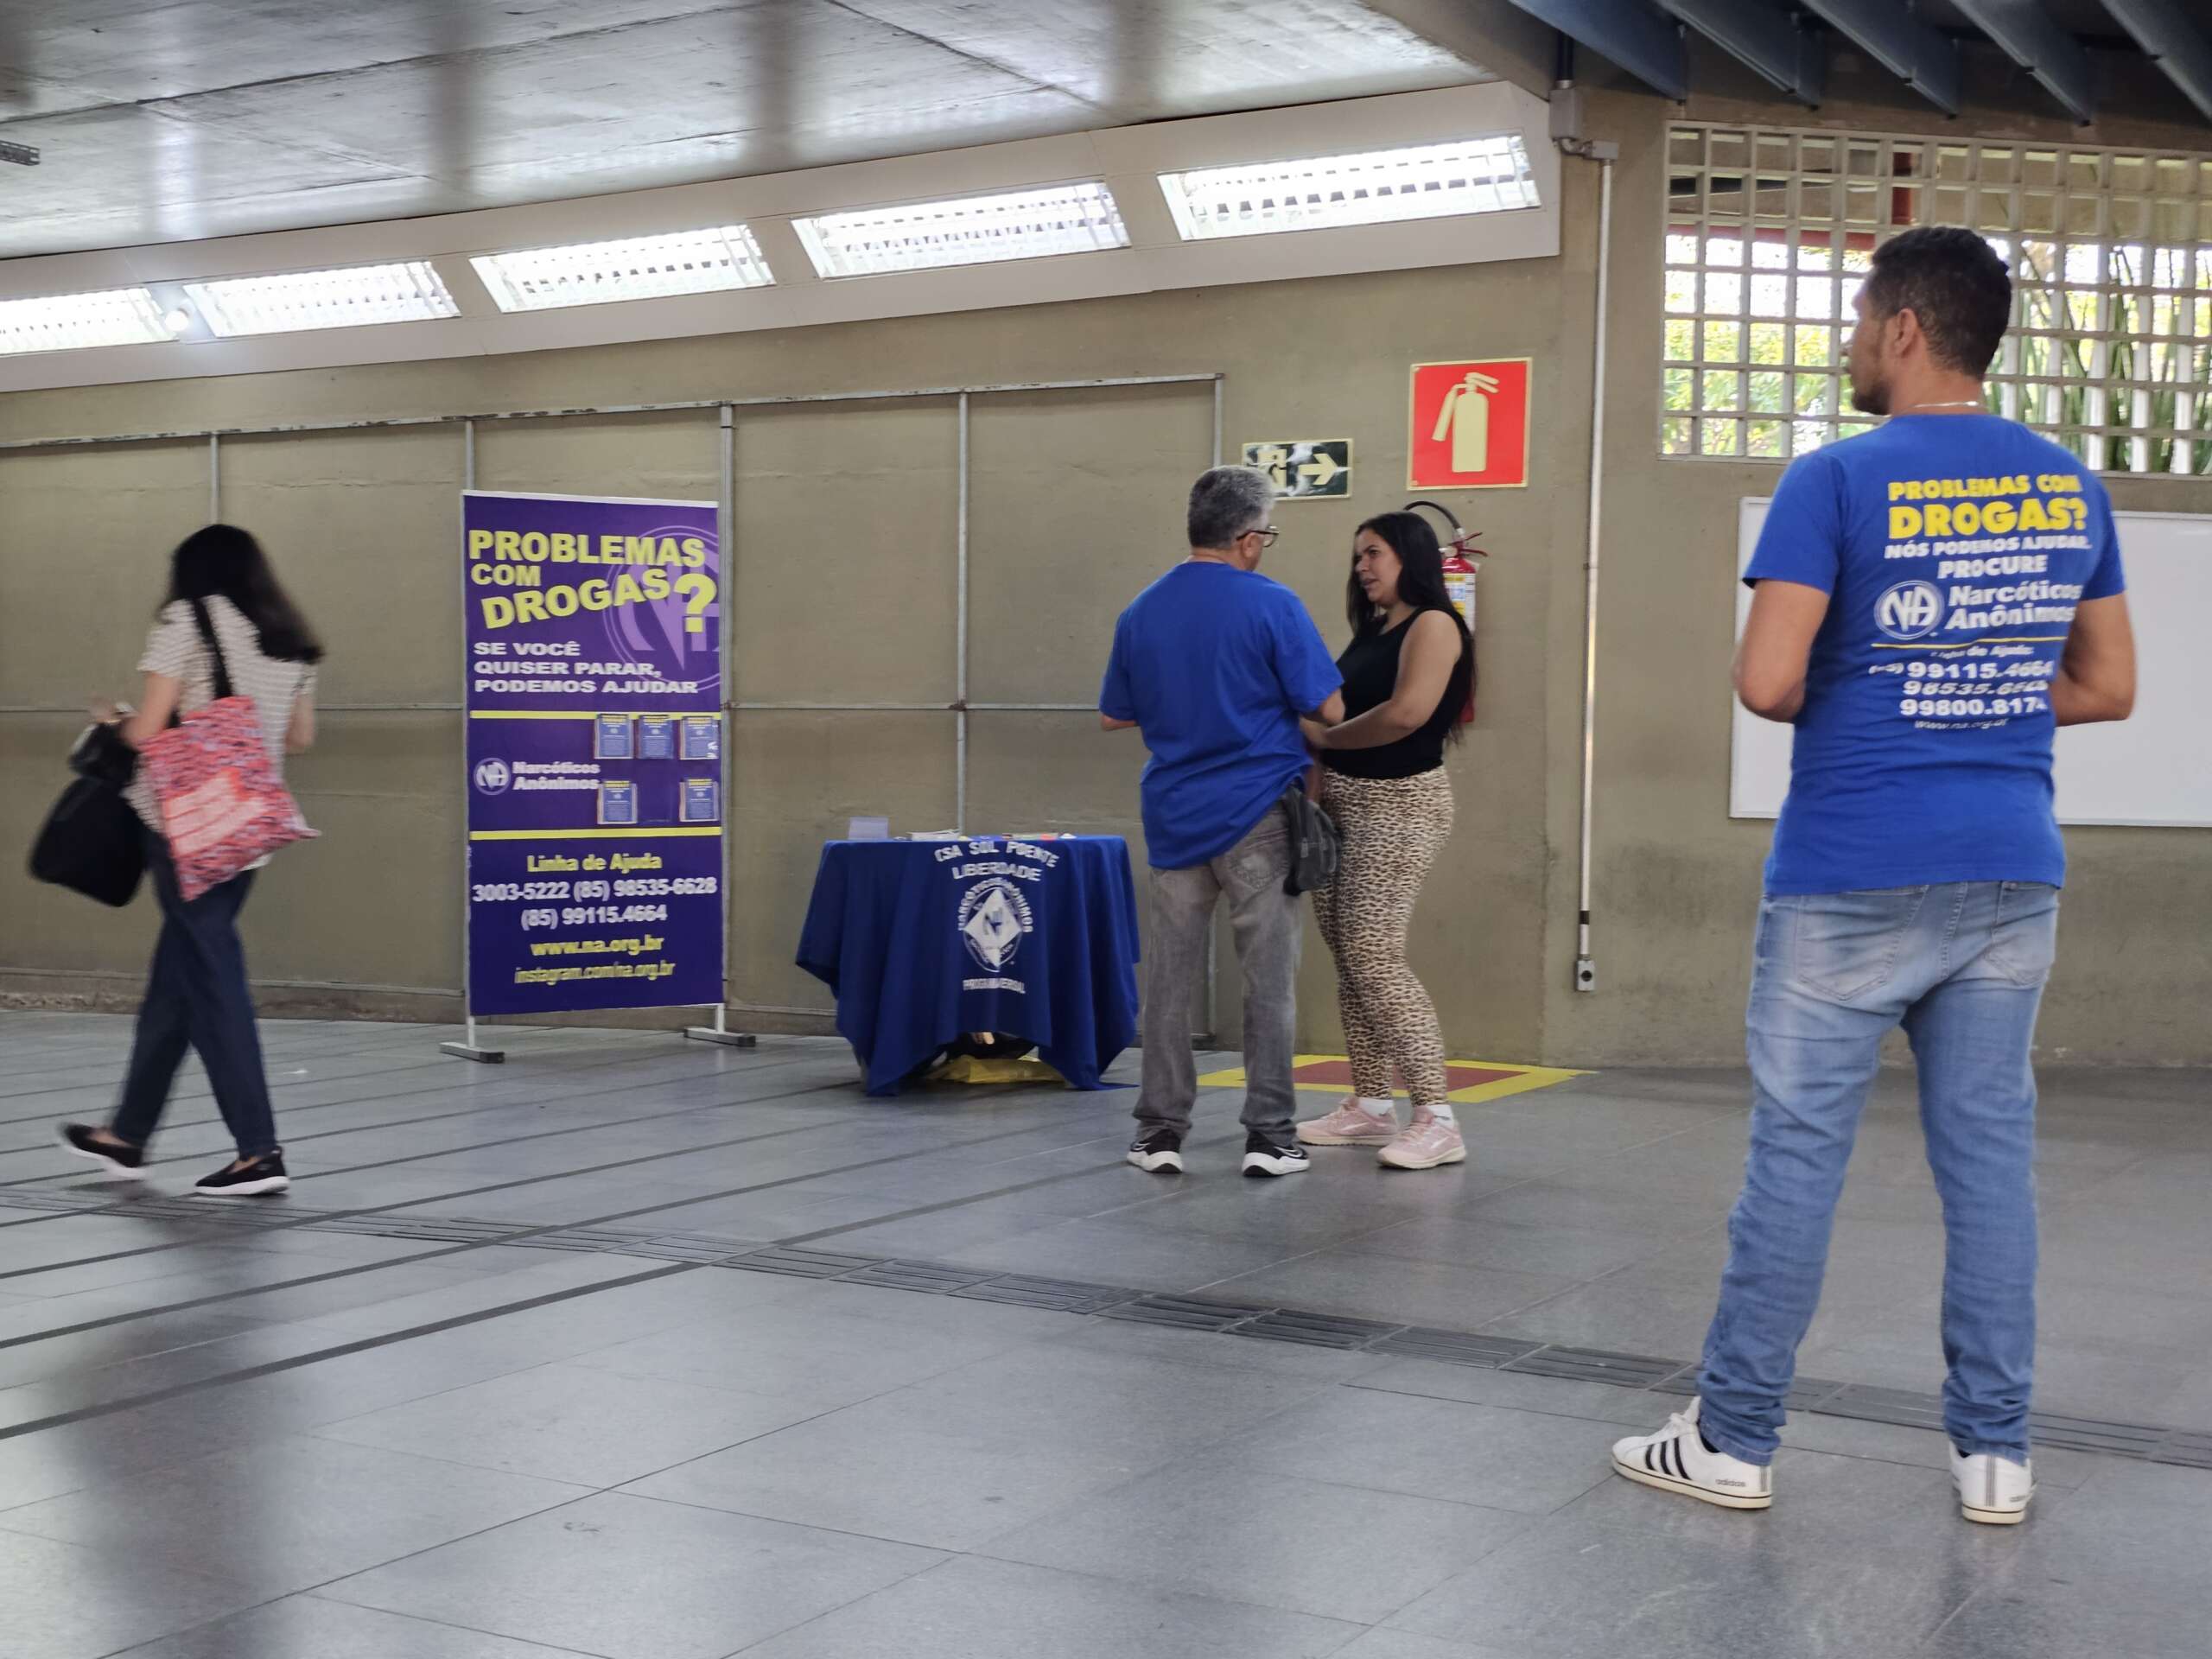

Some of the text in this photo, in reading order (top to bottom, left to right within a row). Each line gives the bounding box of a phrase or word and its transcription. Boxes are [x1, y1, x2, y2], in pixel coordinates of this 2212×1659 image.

[1888, 474, 2082, 501] PROBLEMAS COM
[1888, 498, 2088, 539] DROGAS?
[468, 530, 705, 567] PROBLEMAS
[1884, 539, 1929, 559] NÓS
[1933, 537, 2019, 556] PODEMOS
[471, 563, 541, 587] COM
[1937, 555, 2048, 579] PROCURE
[1948, 580, 2083, 607] Narcóticos
[1944, 602, 2076, 630] Anônimos
[474, 640, 582, 657] SE VOCÊ
[474, 661, 663, 678] QUISER PARAR,
[474, 680, 698, 695] PODEMOS AJUDAR
[526, 853, 663, 874] Linha de Ajuda
[934, 844, 963, 861] CSA
[472, 881, 570, 902] 3003-5222
[574, 880, 611, 902] (85)
[521, 905, 668, 931] (85) 99115.4664
[530, 934, 664, 956] www.na.org.br
